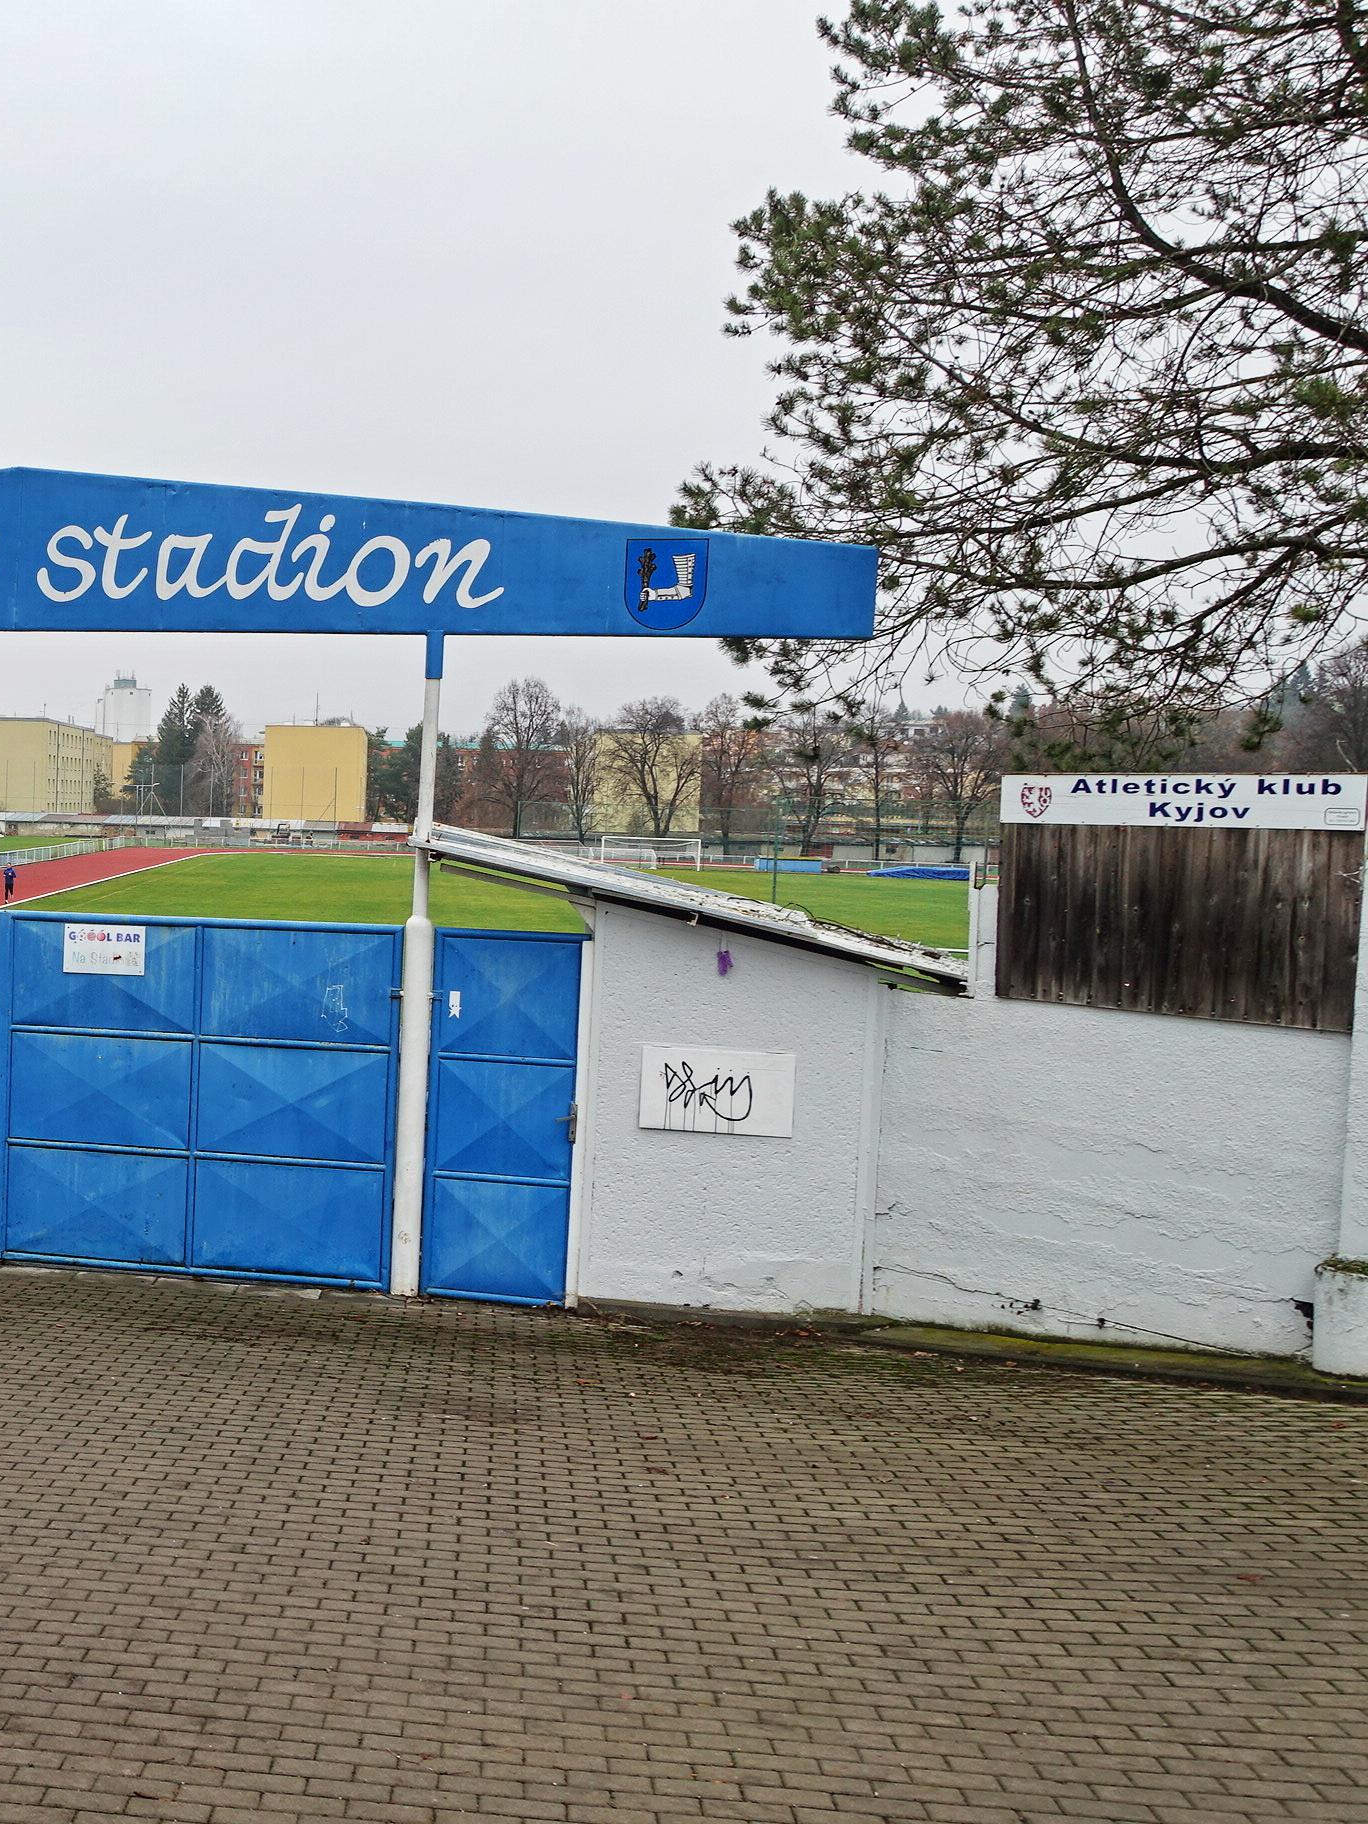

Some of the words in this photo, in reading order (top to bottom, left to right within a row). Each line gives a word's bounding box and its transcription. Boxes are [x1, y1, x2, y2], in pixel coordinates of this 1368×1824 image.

[36, 503, 505, 609] stadion
[1070, 777, 1238, 799] Atletický
[1256, 778, 1343, 796] klub
[1148, 801, 1251, 823] Kyjov
[116, 932, 141, 943] BAR
[72, 951, 86, 964] Na
